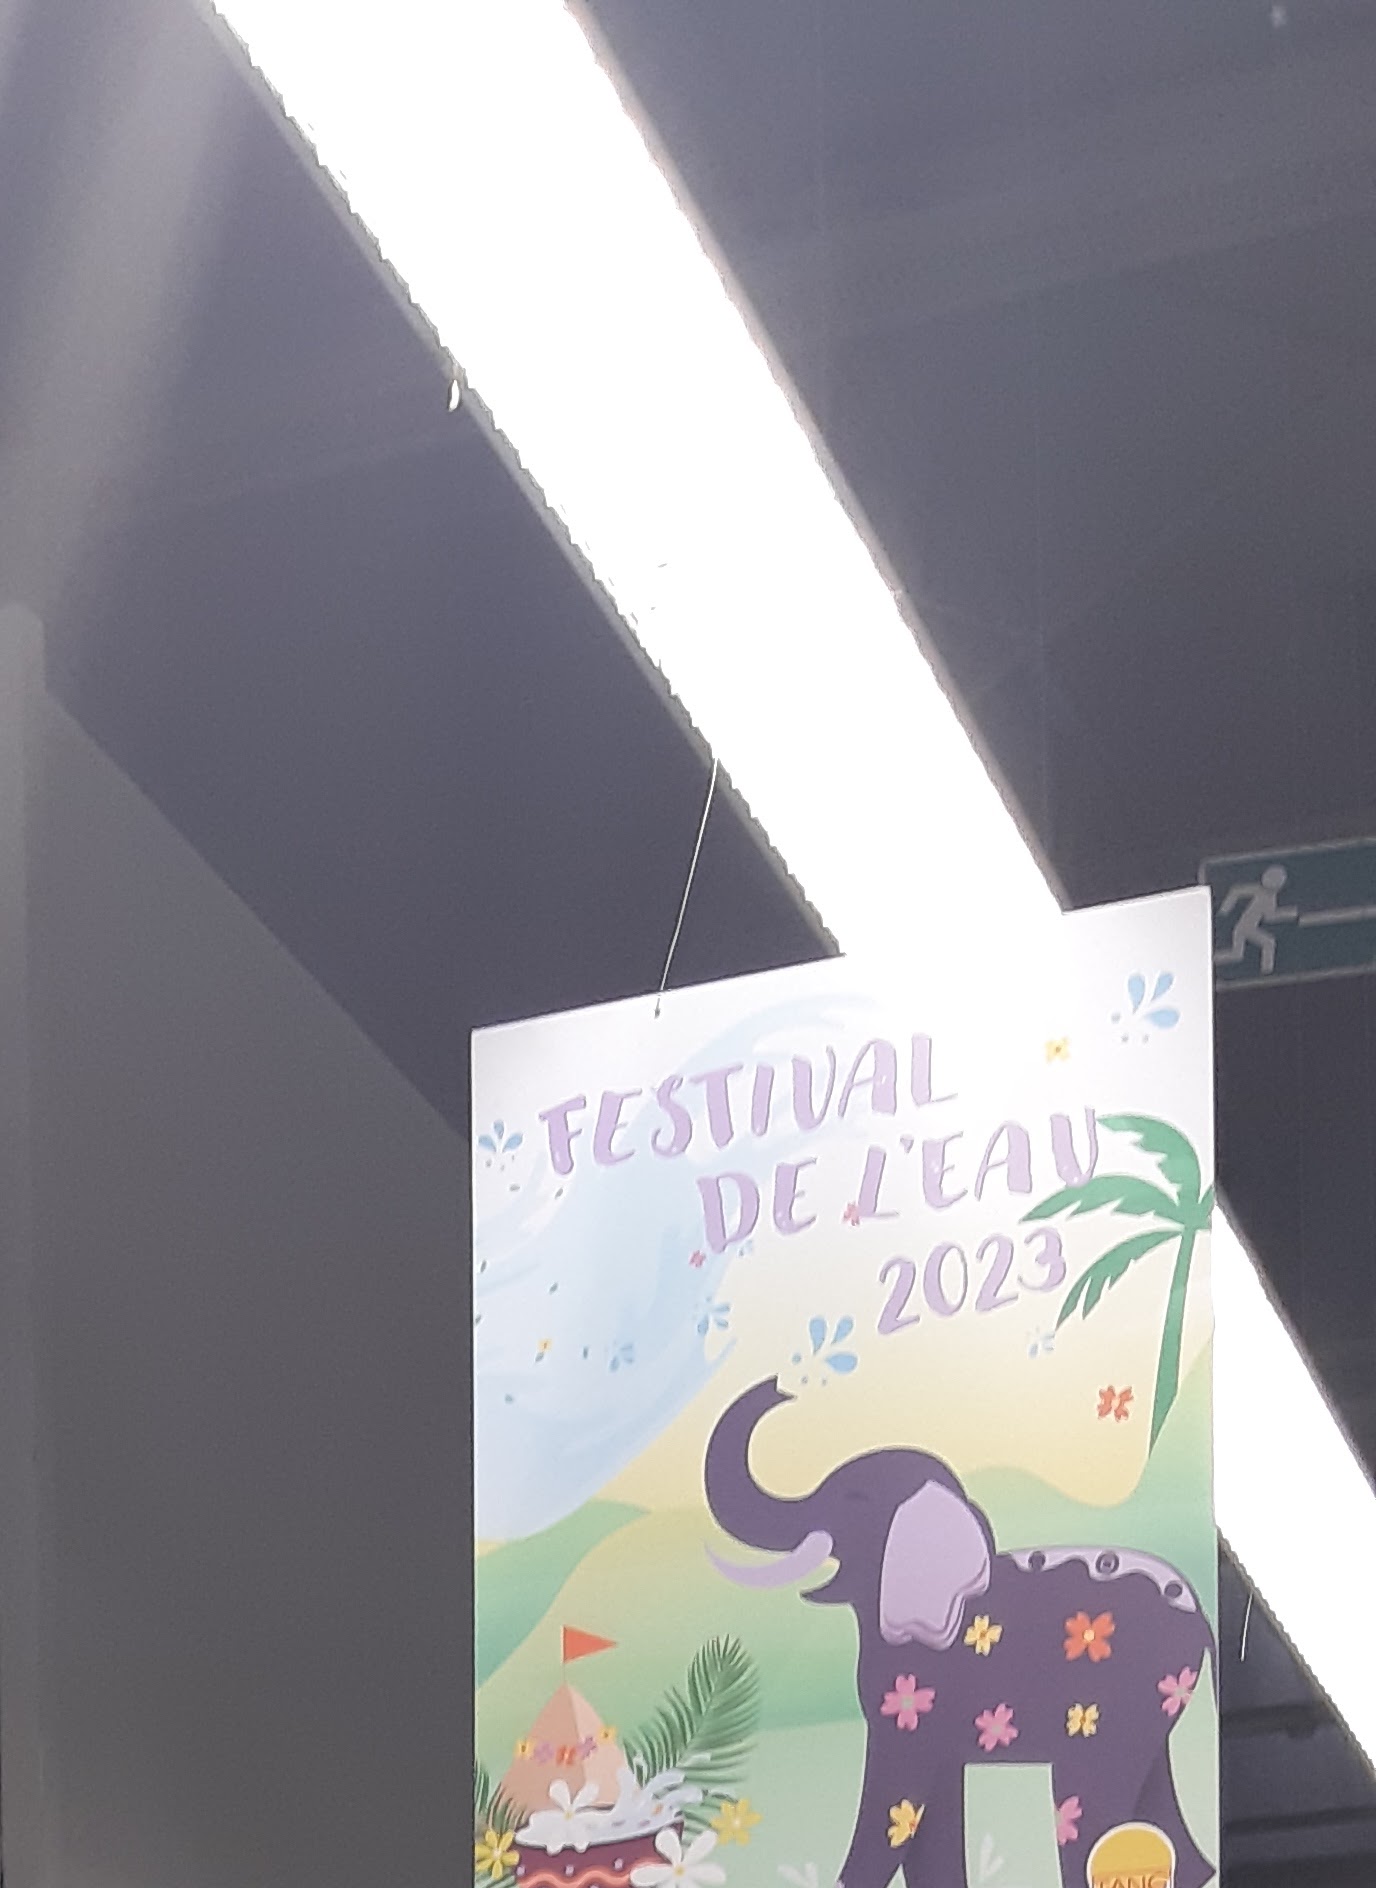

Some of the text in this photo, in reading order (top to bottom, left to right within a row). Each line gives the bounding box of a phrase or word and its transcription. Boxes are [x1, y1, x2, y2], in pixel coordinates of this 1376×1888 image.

[539, 1033, 958, 1176] FESTIVAL
[697, 1107, 1099, 1254] DE L'EAU
[877, 1226, 1067, 1336] 2023
